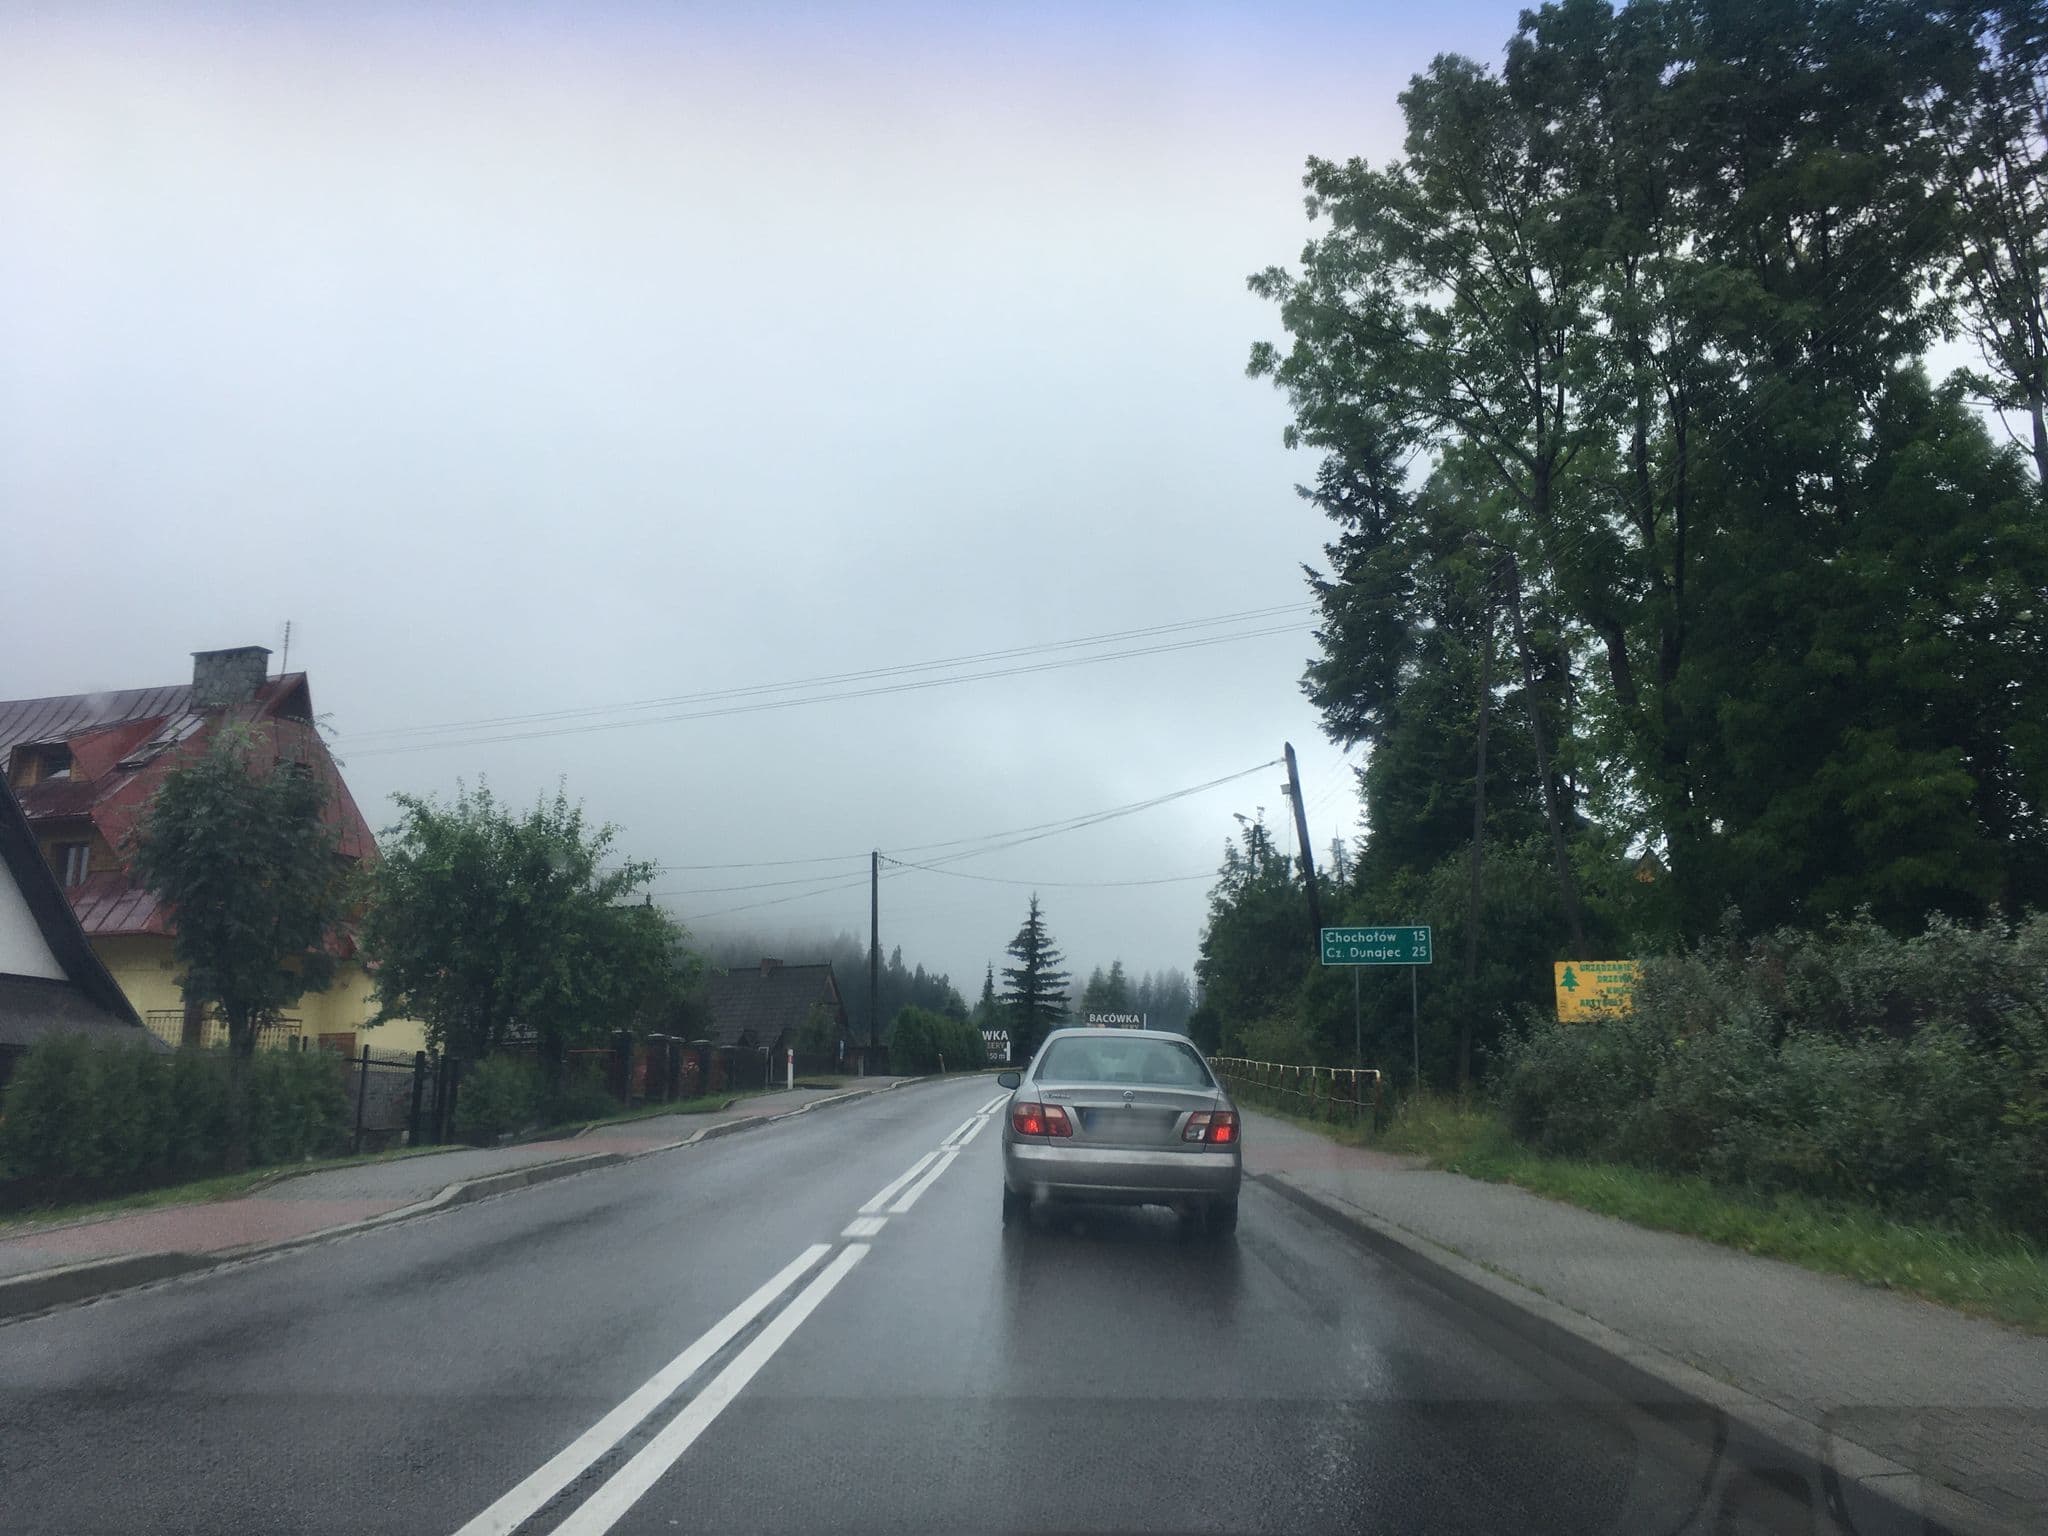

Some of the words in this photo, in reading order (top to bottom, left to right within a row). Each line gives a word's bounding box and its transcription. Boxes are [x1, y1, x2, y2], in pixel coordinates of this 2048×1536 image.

[1325, 931, 1396, 942] Chochołów
[1413, 931, 1426, 941] 15
[1326, 948, 1345, 958] Cz.
[1350, 947, 1401, 960] Dunajec
[1412, 946, 1427, 957] 25
[1089, 1013, 1140, 1023] BACÓWKA
